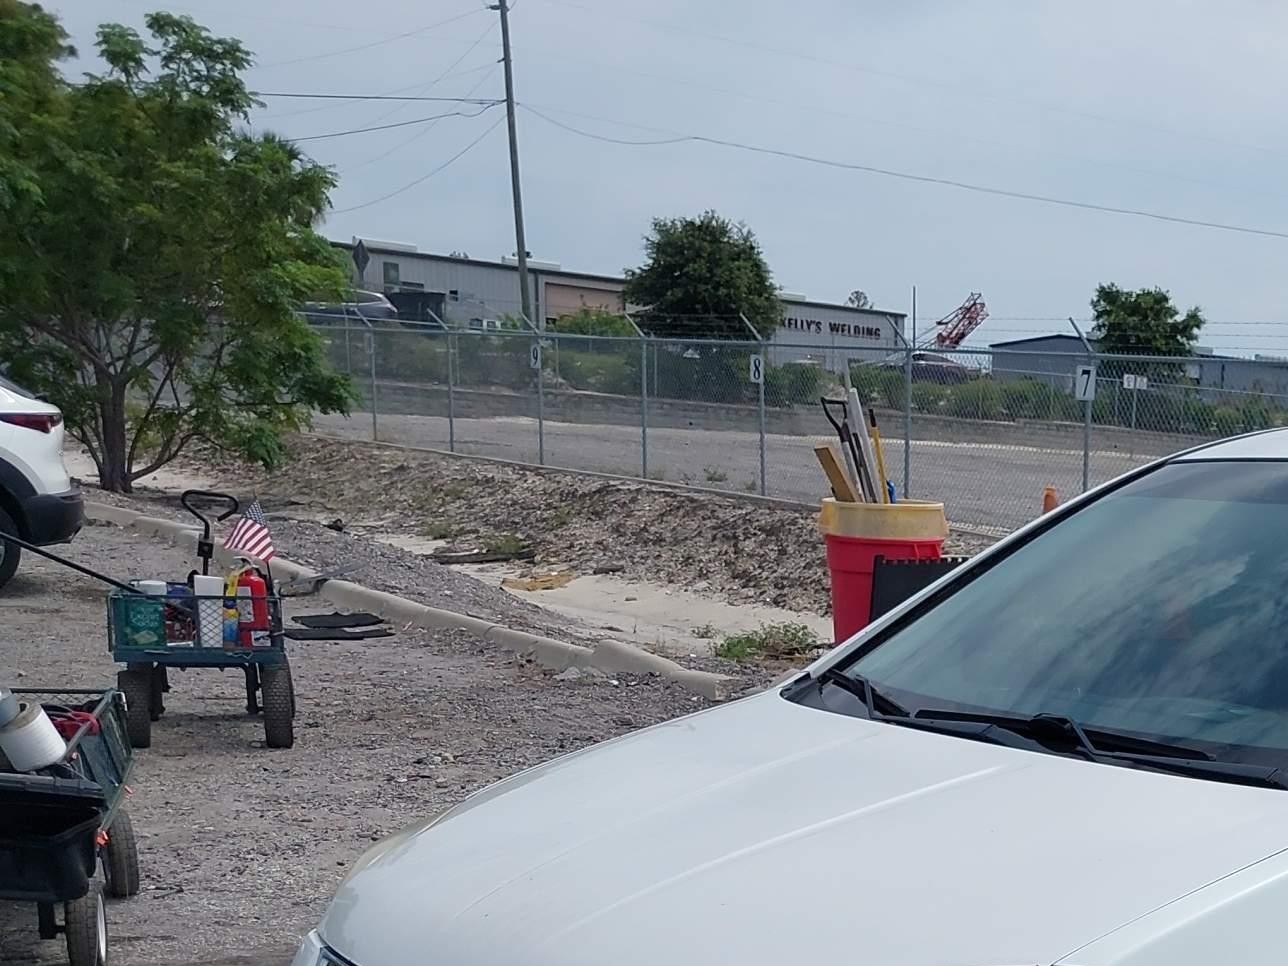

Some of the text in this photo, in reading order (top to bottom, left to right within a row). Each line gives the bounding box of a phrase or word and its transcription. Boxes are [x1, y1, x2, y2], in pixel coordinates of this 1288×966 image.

[829, 321, 881, 337] WELDING
[753, 358, 761, 380] 8
[1081, 369, 1092, 397] 7
